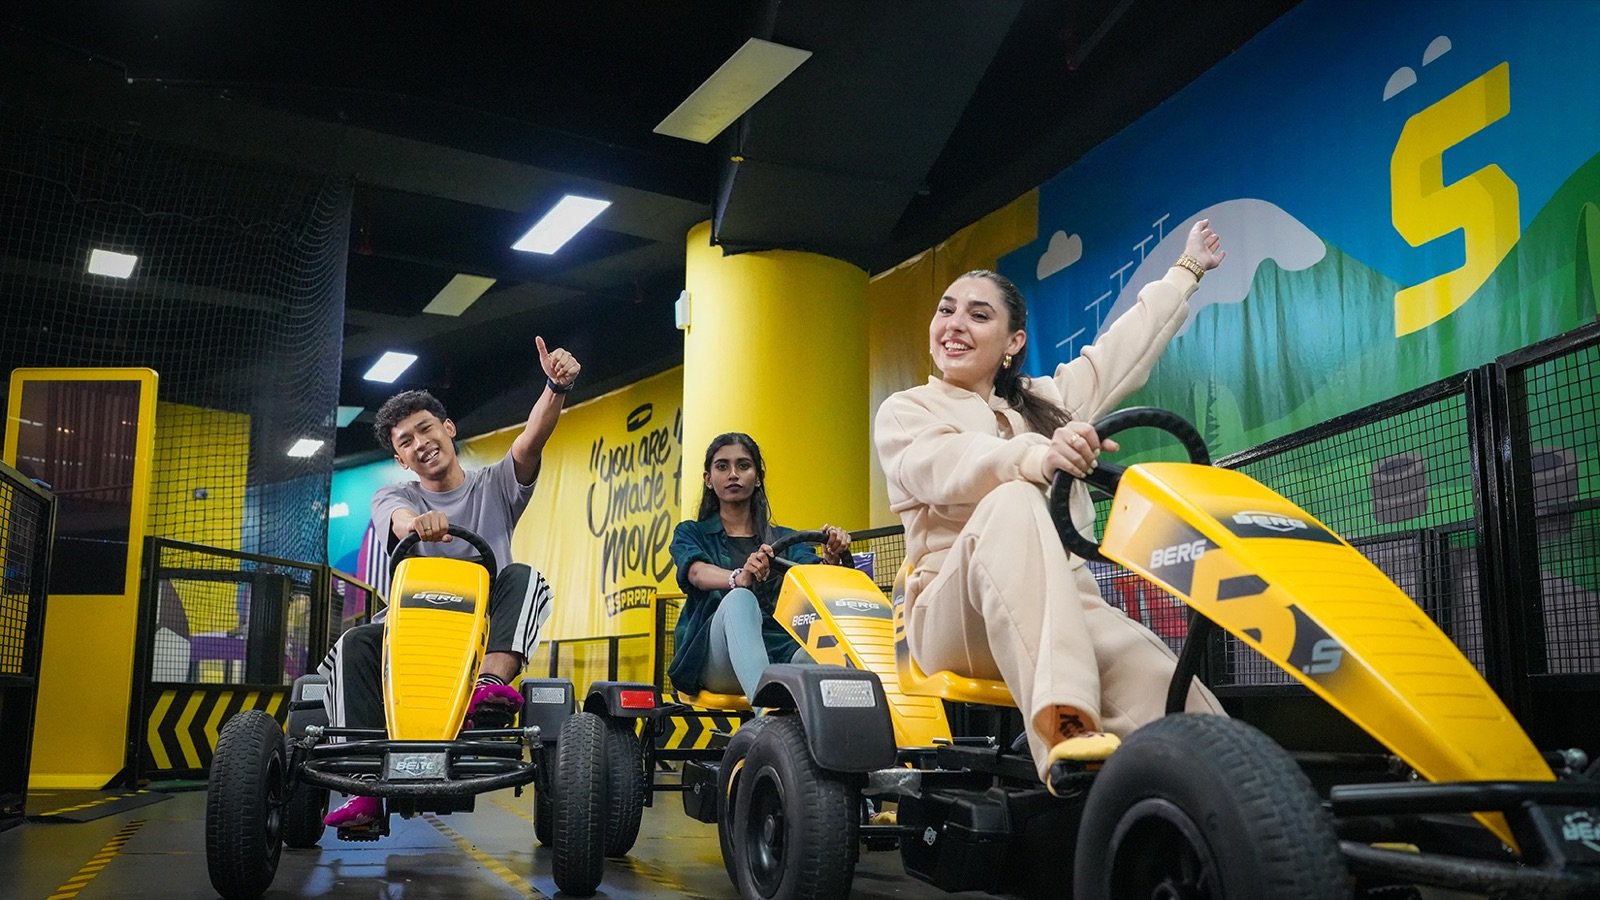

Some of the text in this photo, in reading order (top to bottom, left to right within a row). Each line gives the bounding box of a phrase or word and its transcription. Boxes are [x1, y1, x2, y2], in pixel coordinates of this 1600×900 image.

[601, 510, 674, 595] move
[1150, 539, 1207, 569] BERG
[835, 599, 880, 610] BERG
[791, 613, 817, 626] BERG
